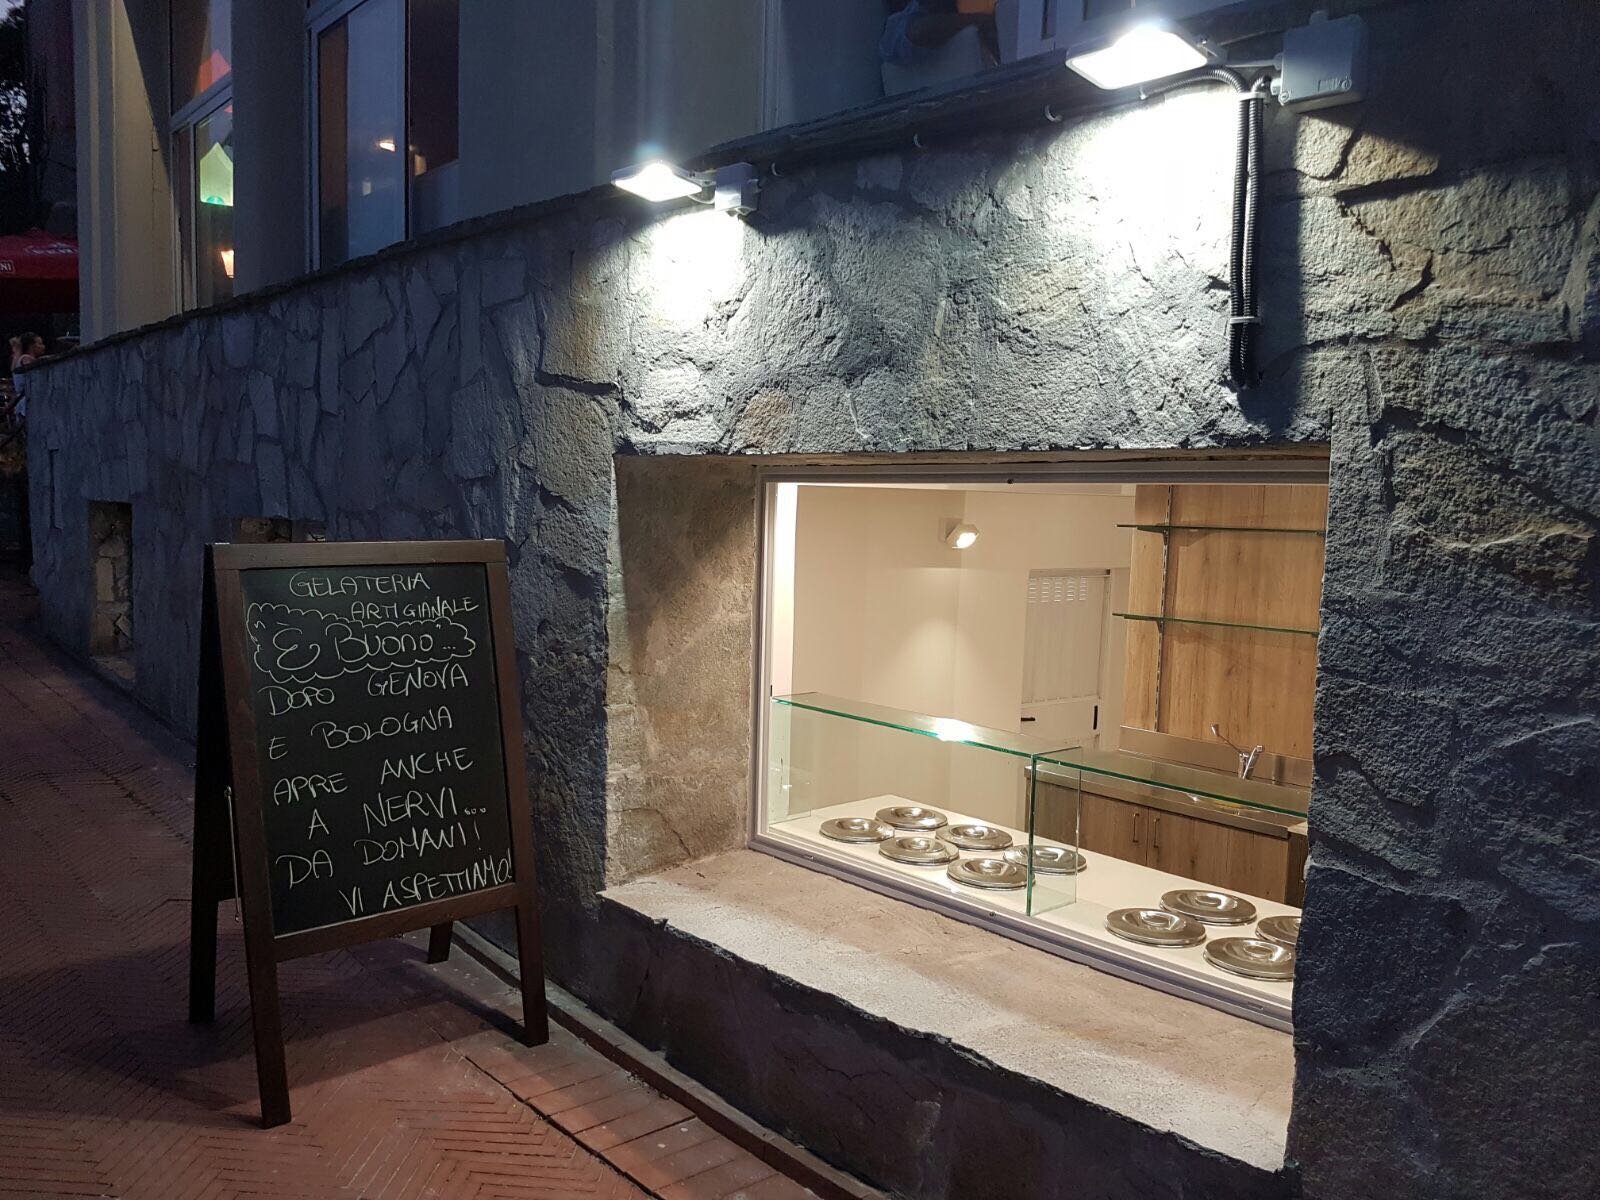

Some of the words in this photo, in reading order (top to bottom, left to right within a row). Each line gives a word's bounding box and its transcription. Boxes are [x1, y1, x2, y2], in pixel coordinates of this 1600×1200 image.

[289, 571, 431, 598] GELATERIA
[351, 596, 479, 620] ARTIGIANALE
[367, 661, 469, 697] GENOVA
[269, 736, 289, 760] E
[310, 706, 453, 749] BOLOGNA
[273, 773, 348, 806] APRE
[380, 748, 474, 785] ANCHE
[308, 808, 330, 840] A
[275, 849, 333, 889] DA
[338, 885, 364, 916] VI
